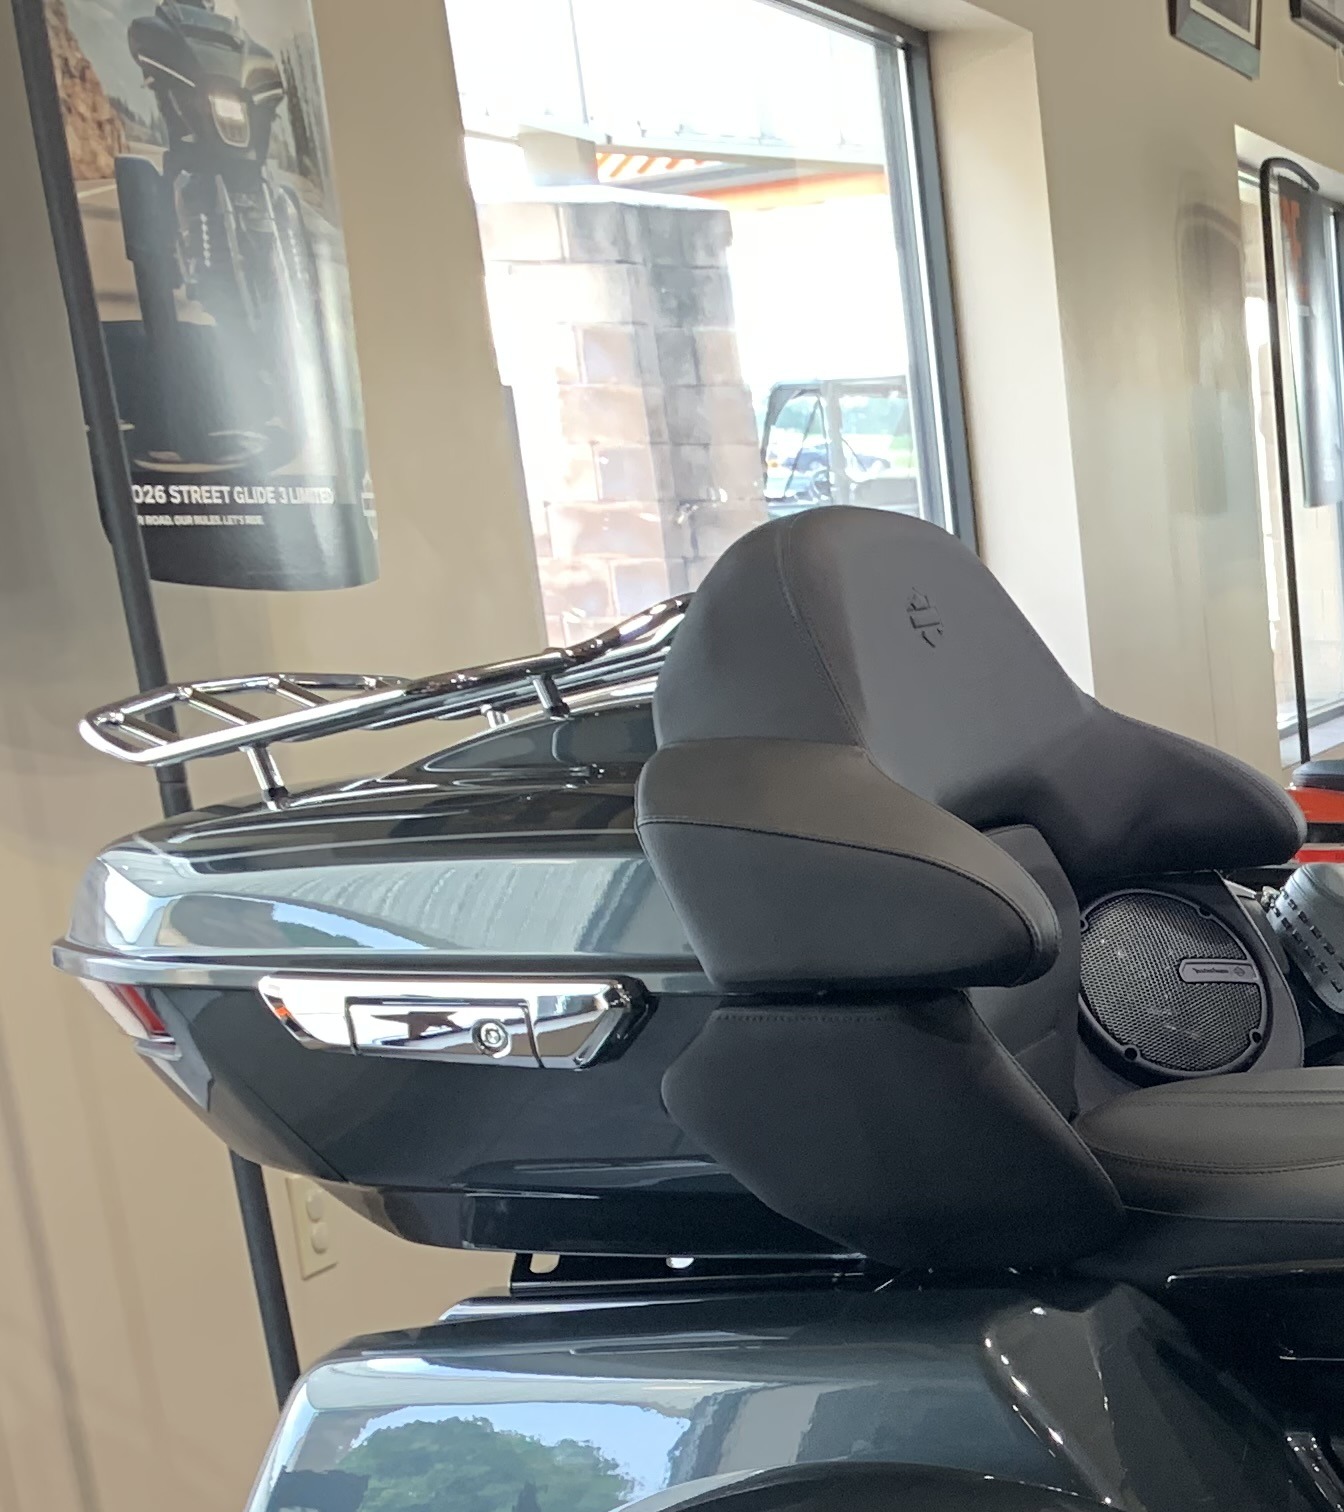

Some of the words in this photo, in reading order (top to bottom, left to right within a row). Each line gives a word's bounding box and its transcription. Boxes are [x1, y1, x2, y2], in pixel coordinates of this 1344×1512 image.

[131, 484, 167, 505] 026
[168, 484, 232, 505] STREET
[233, 485, 276, 505] GLIDE
[279, 486, 287, 505] 3
[288, 486, 336, 505] LIMITED
